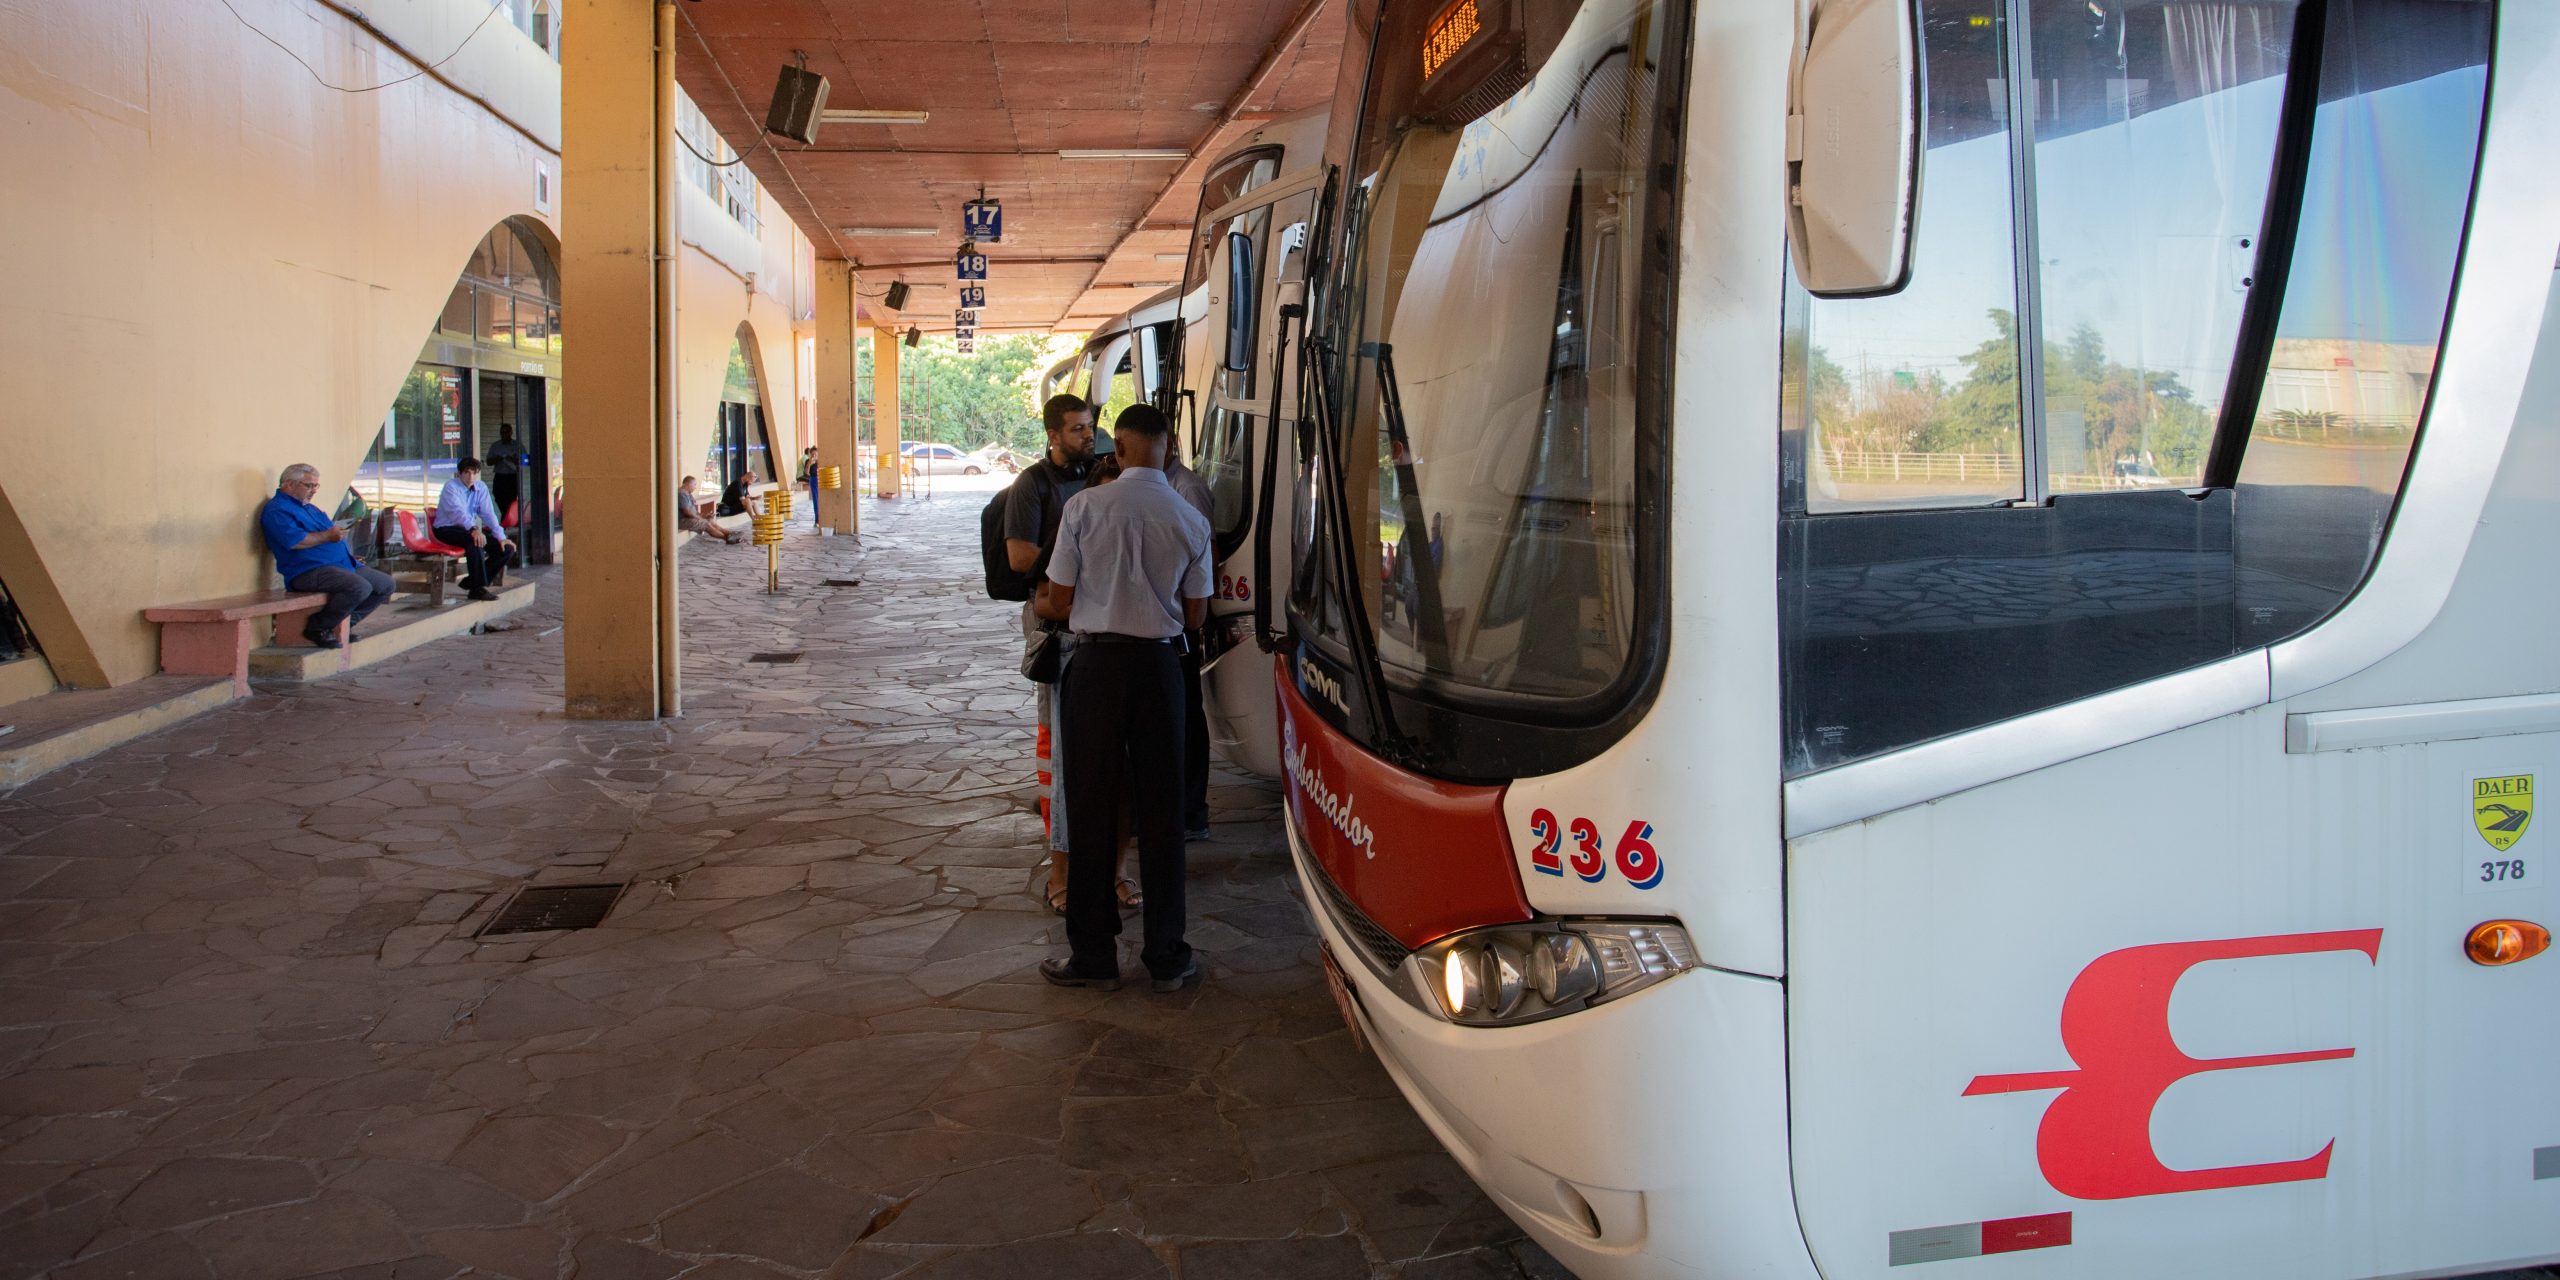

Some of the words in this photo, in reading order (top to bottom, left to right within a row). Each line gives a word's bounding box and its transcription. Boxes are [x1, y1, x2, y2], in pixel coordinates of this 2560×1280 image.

[966, 205, 999, 225] 17
[959, 255, 985, 272] 18
[961, 288, 983, 302] 19
[956, 310, 974, 322] 20
[959, 340, 972, 349] 22
[1300, 656, 1351, 718] COMIL
[1283, 719, 1376, 860] Embaixador
[2478, 777, 2529, 797] DAER
[1530, 807, 1664, 890] 236
[2495, 837, 2510, 846] RS
[2480, 859, 2525, 882] 378
